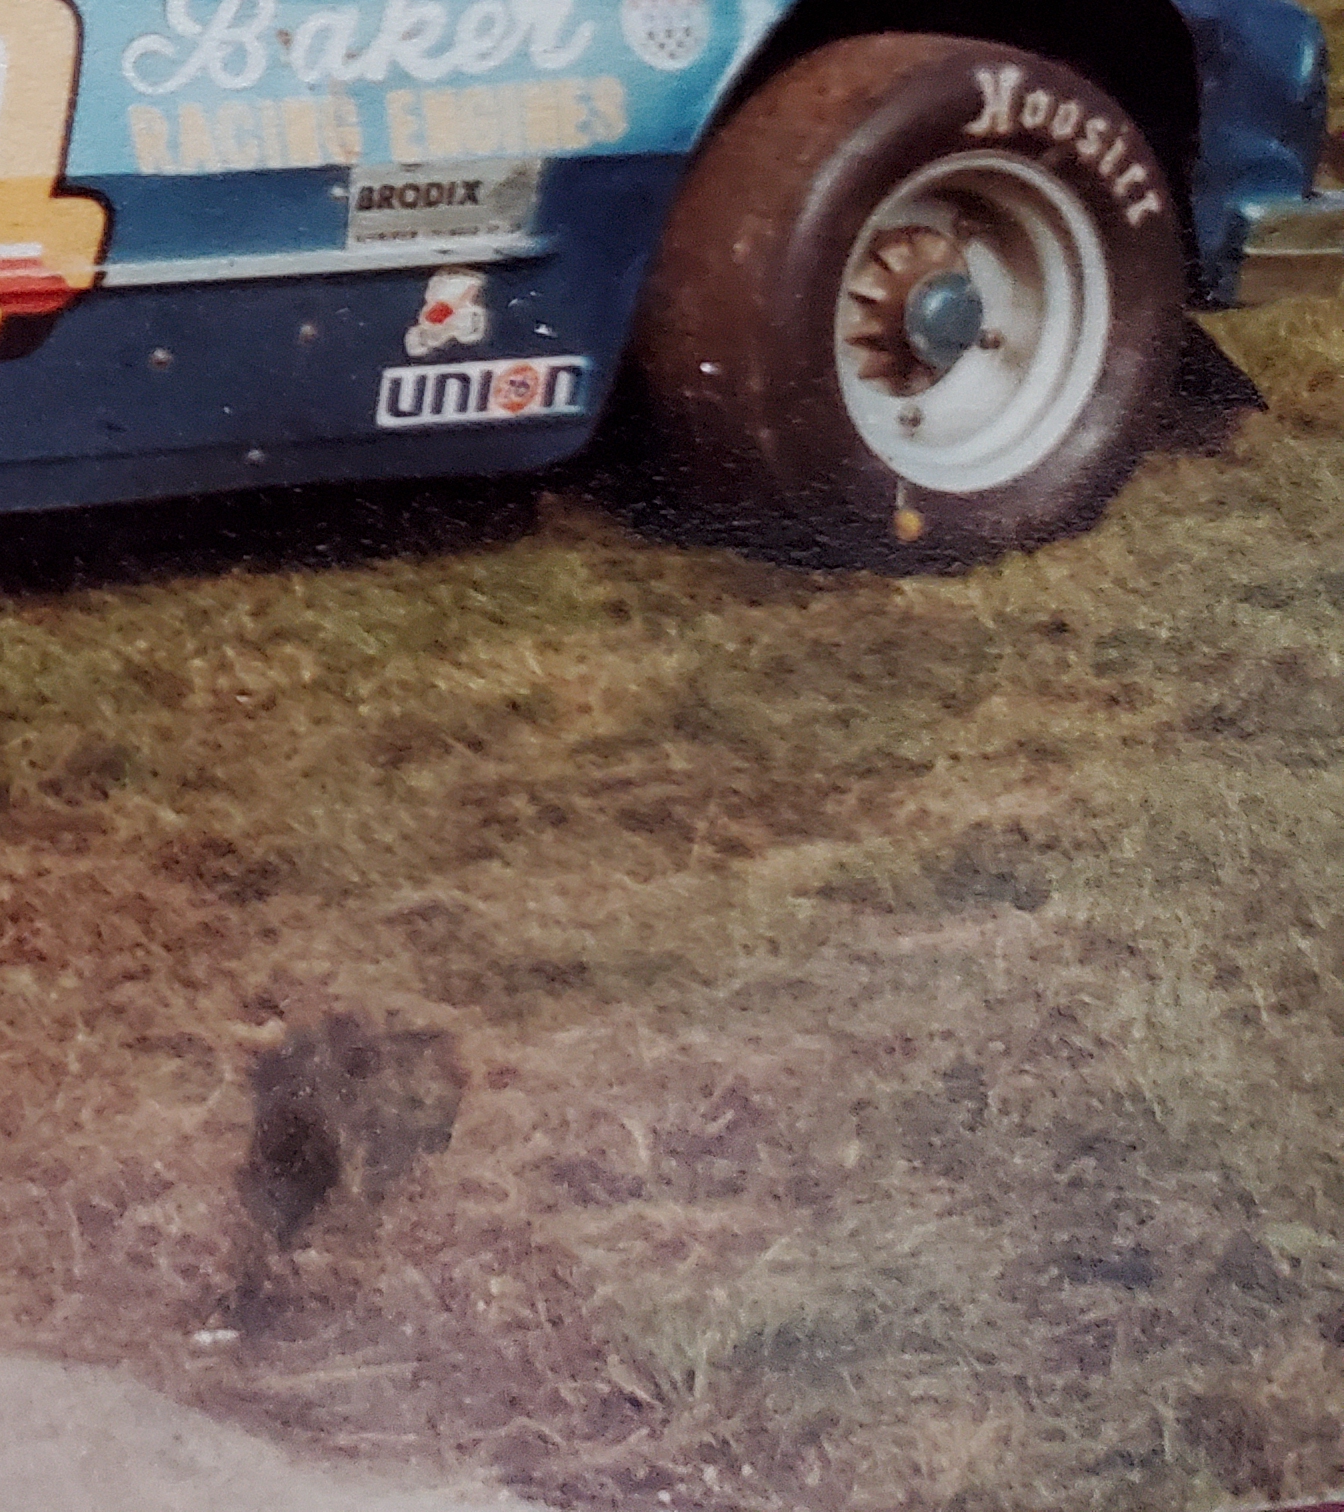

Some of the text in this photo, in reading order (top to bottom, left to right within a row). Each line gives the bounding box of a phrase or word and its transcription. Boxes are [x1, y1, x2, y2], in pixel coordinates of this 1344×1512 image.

[127, 75, 629, 176] RACING ENGINES
[960, 61, 1164, 227] Hoosier
[355, 180, 484, 210] BRODIX
